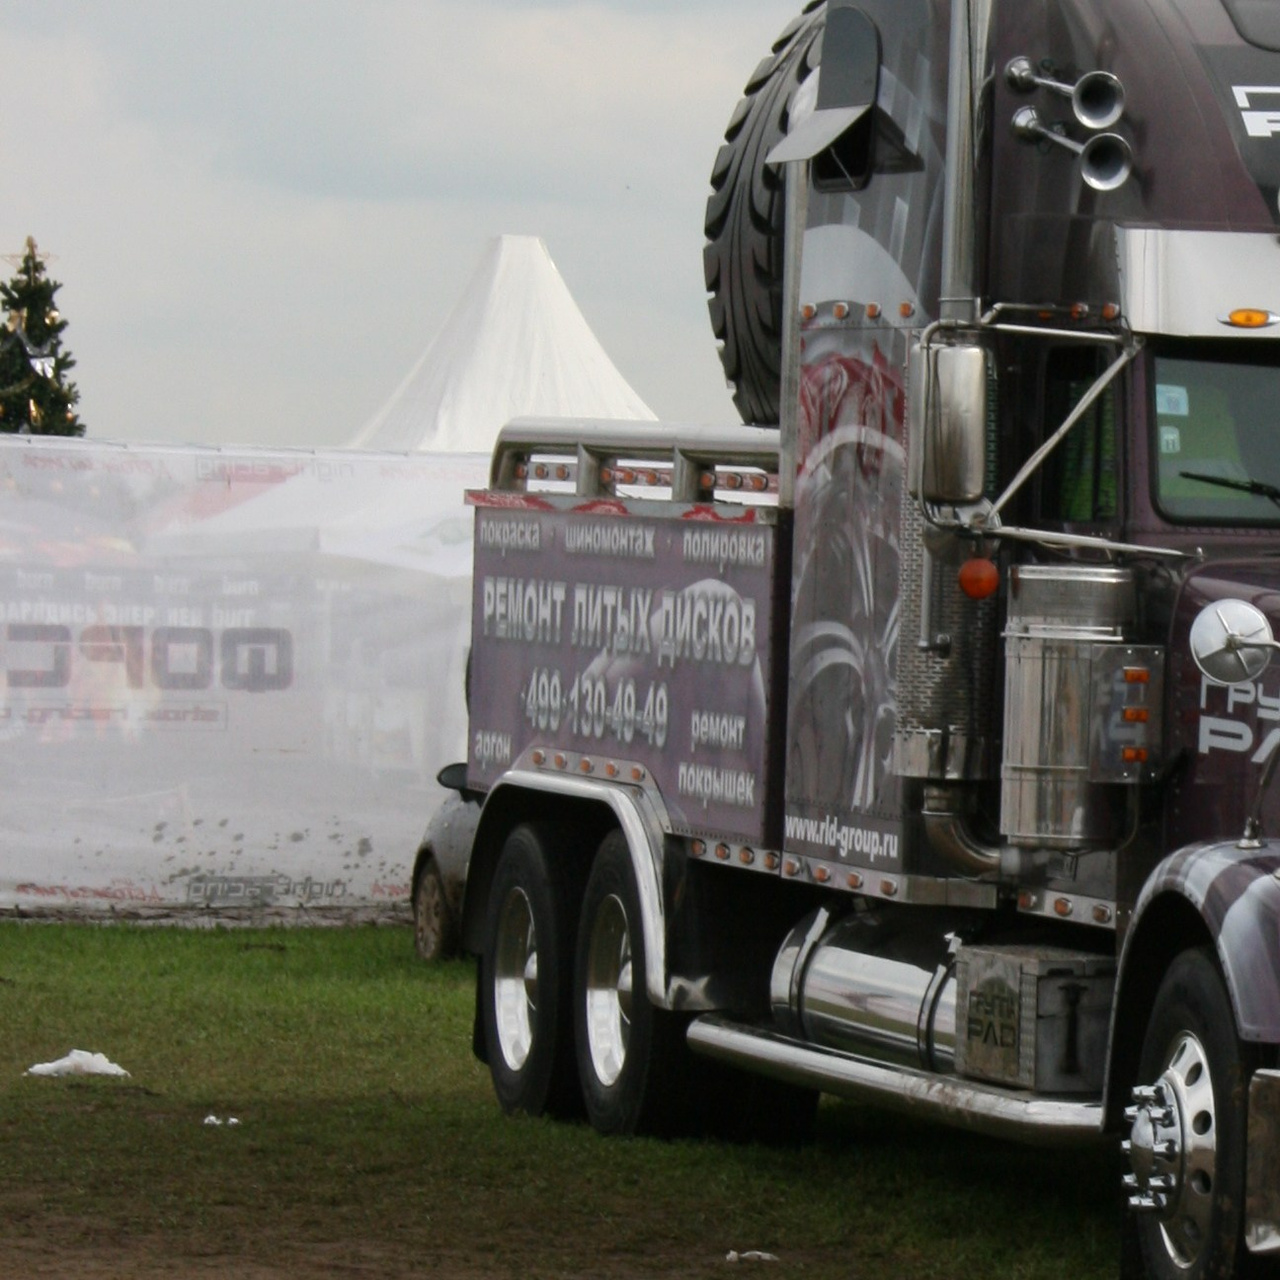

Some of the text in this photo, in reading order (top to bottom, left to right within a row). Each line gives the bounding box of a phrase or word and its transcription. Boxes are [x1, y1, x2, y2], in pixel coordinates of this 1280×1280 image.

[480, 518, 765, 572] покраска шиномонтаж полировка
[483, 577, 566, 638] РЕМОНТ
[658, 590, 757, 663] ДИСКОВ
[475, 730, 512, 770] аргон
[691, 710, 745, 751] ремонт
[678, 761, 755, 808] покрышек
[785, 815, 898, 862] www.rld-group.ru
